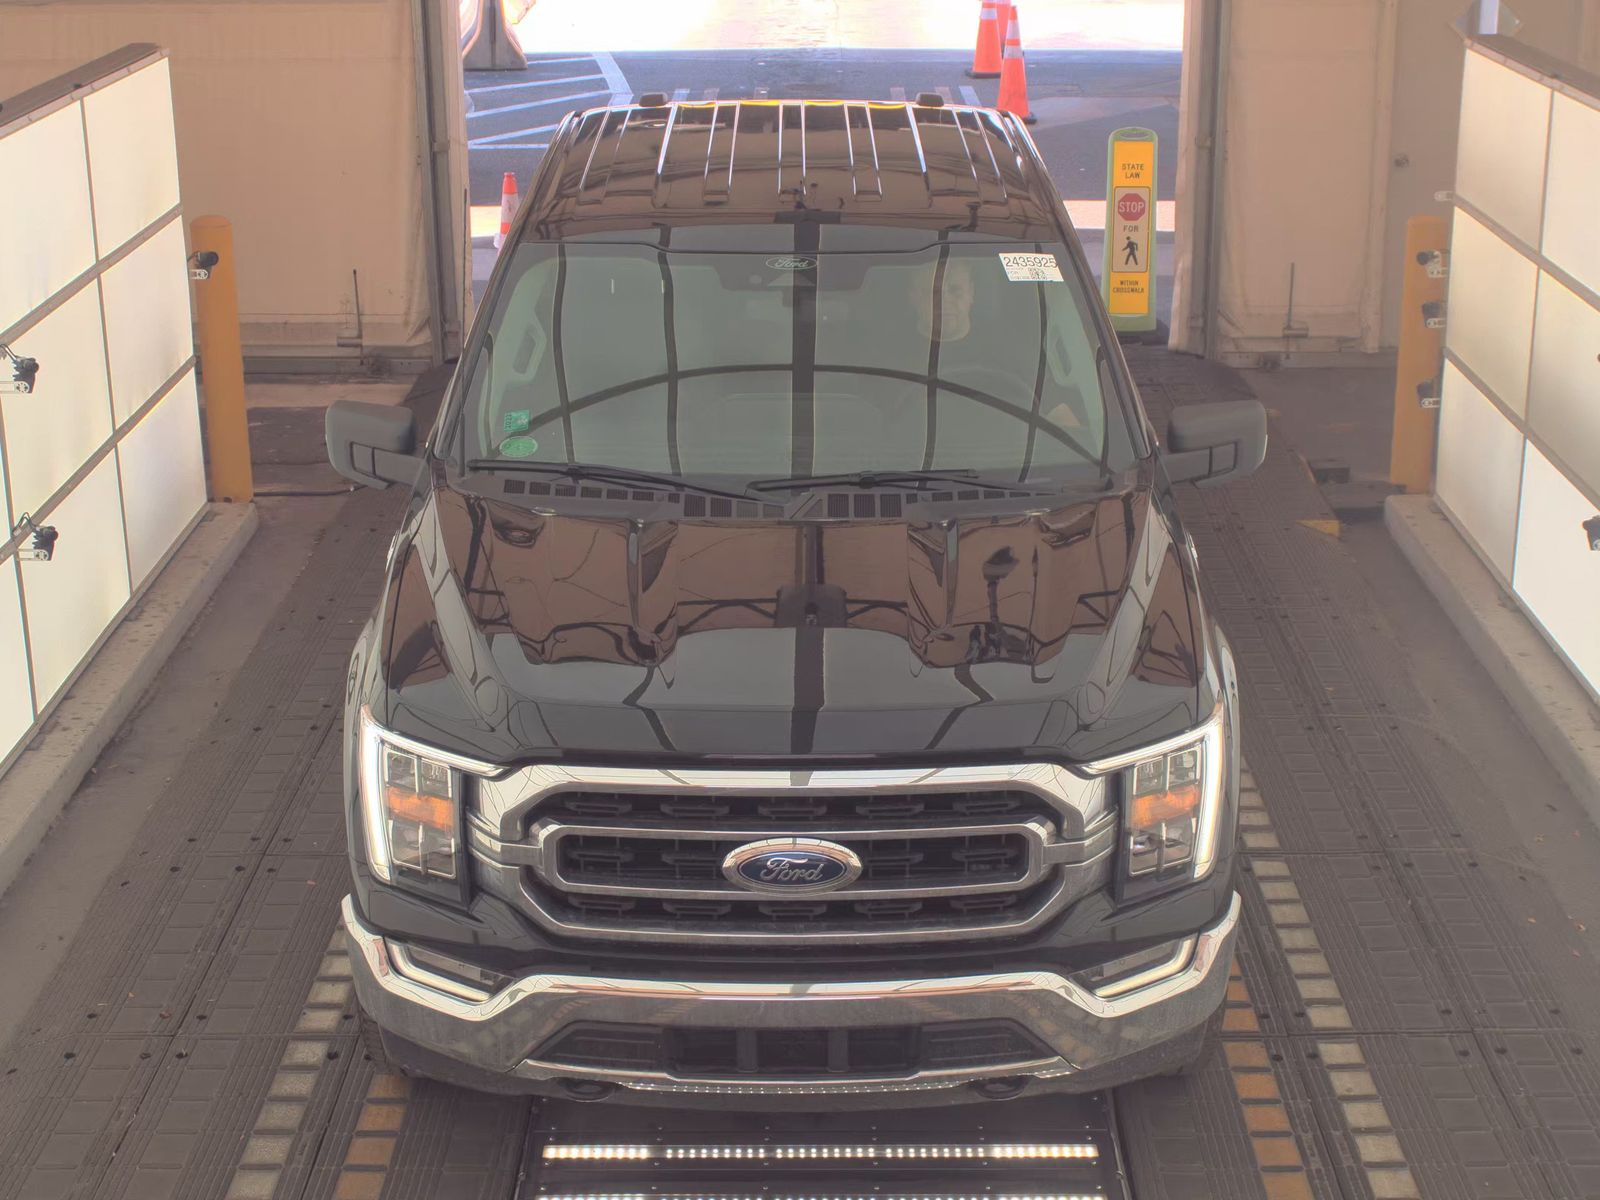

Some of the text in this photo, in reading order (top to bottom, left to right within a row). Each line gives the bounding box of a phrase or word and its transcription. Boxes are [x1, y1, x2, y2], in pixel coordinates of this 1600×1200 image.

[1121, 163, 1144, 171] STATE
[1119, 201, 1145, 213] STOP
[1003, 256, 1058, 268] 2435925
[760, 857, 825, 881] Ford
